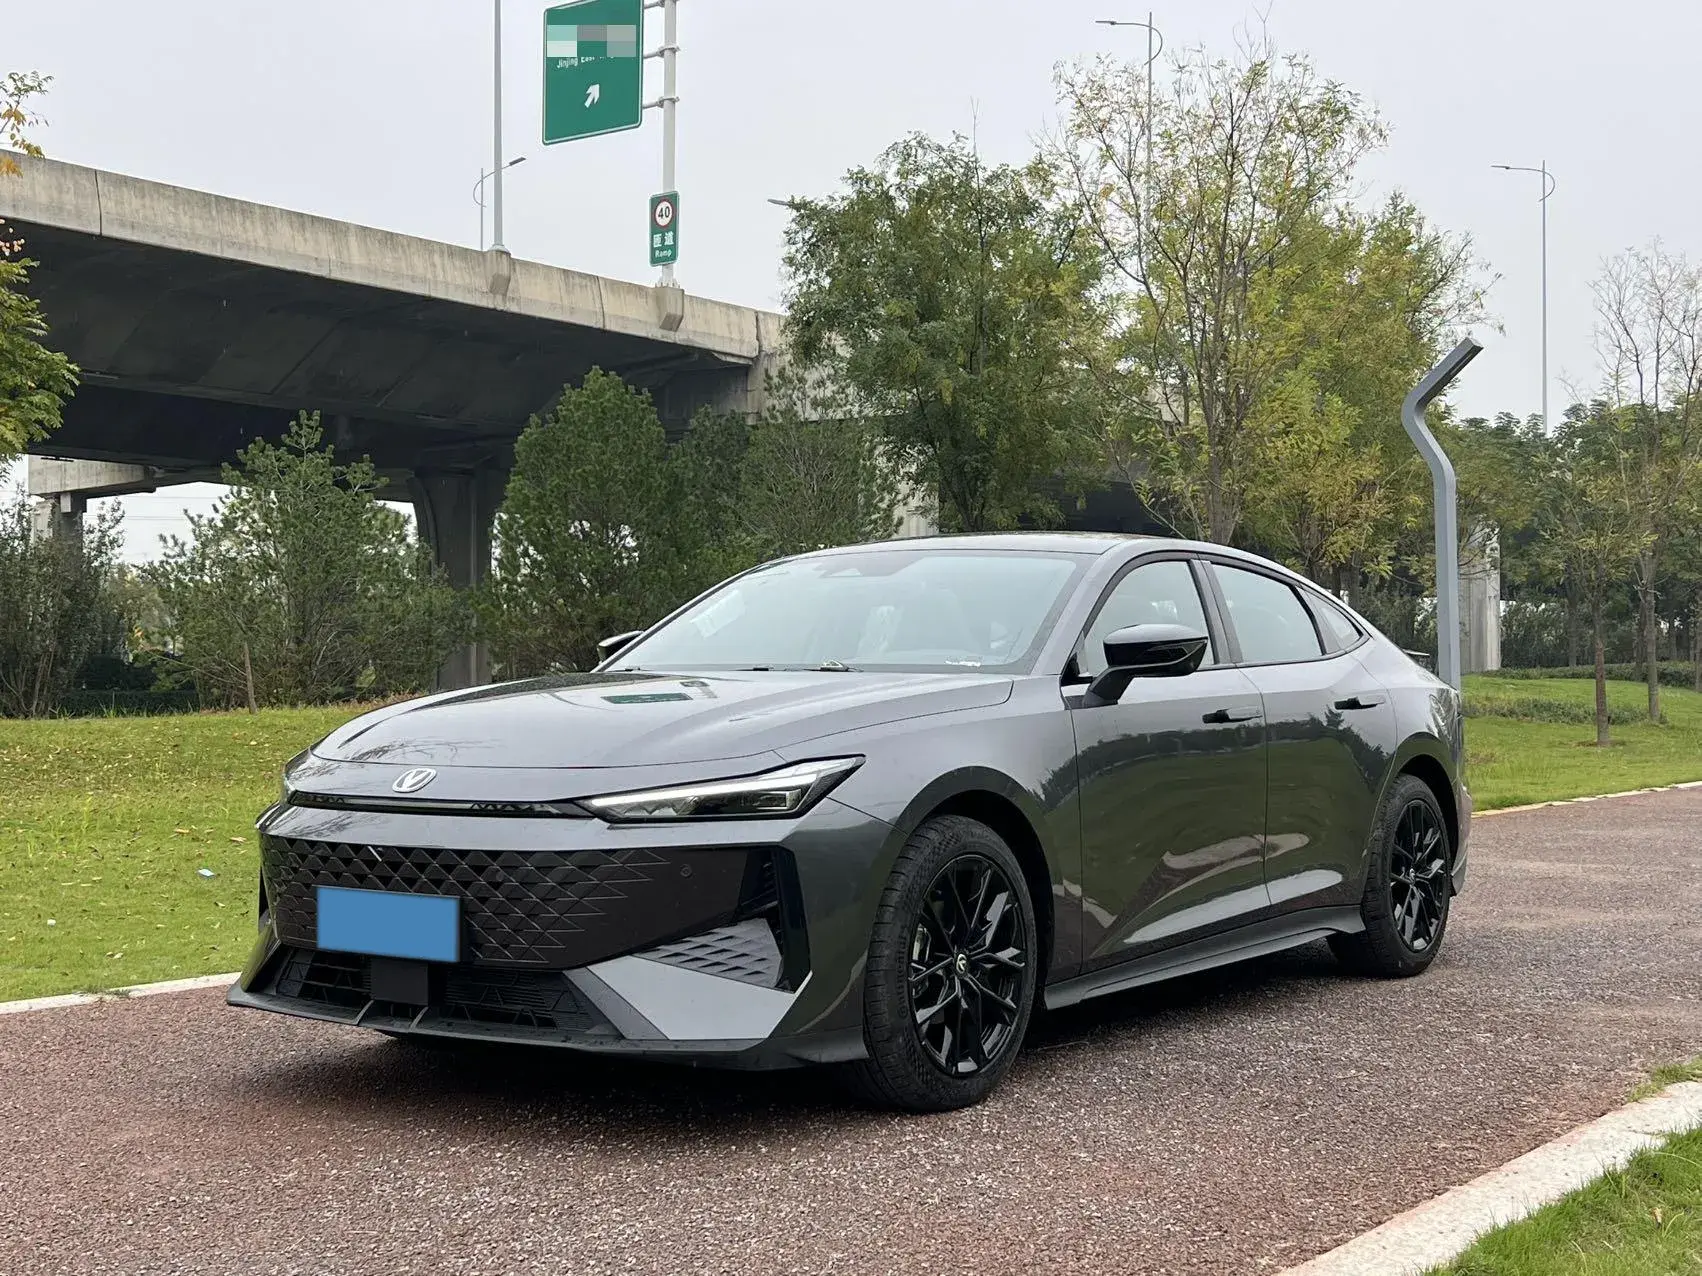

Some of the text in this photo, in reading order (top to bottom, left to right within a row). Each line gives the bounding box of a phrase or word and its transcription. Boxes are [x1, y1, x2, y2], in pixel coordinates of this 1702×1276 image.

[658, 206, 670, 219] 40
[653, 231, 674, 248] 匝道
[655, 250, 672, 258] Ramp
